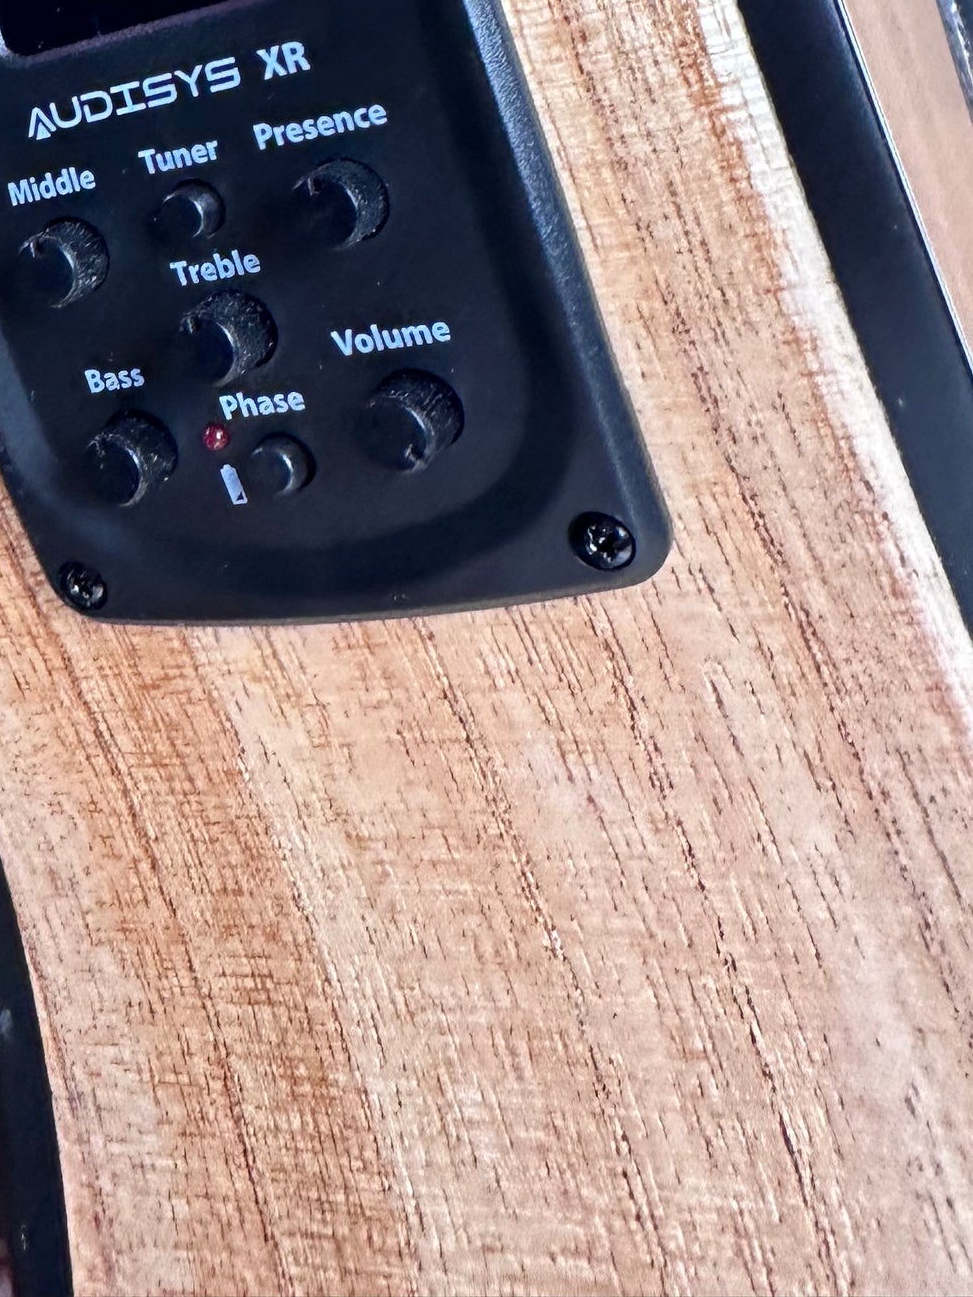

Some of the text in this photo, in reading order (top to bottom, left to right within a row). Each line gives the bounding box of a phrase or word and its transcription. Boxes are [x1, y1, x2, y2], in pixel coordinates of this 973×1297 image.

[27, 40, 311, 140] AUDISYS XR
[253, 103, 388, 151] Presence
[138, 139, 218, 175] Tuner
[7, 166, 96, 207] Middle
[169, 249, 261, 287] Treble
[330, 317, 452, 358] Volume
[84, 367, 145, 395] Bass
[218, 388, 306, 421] Phase
